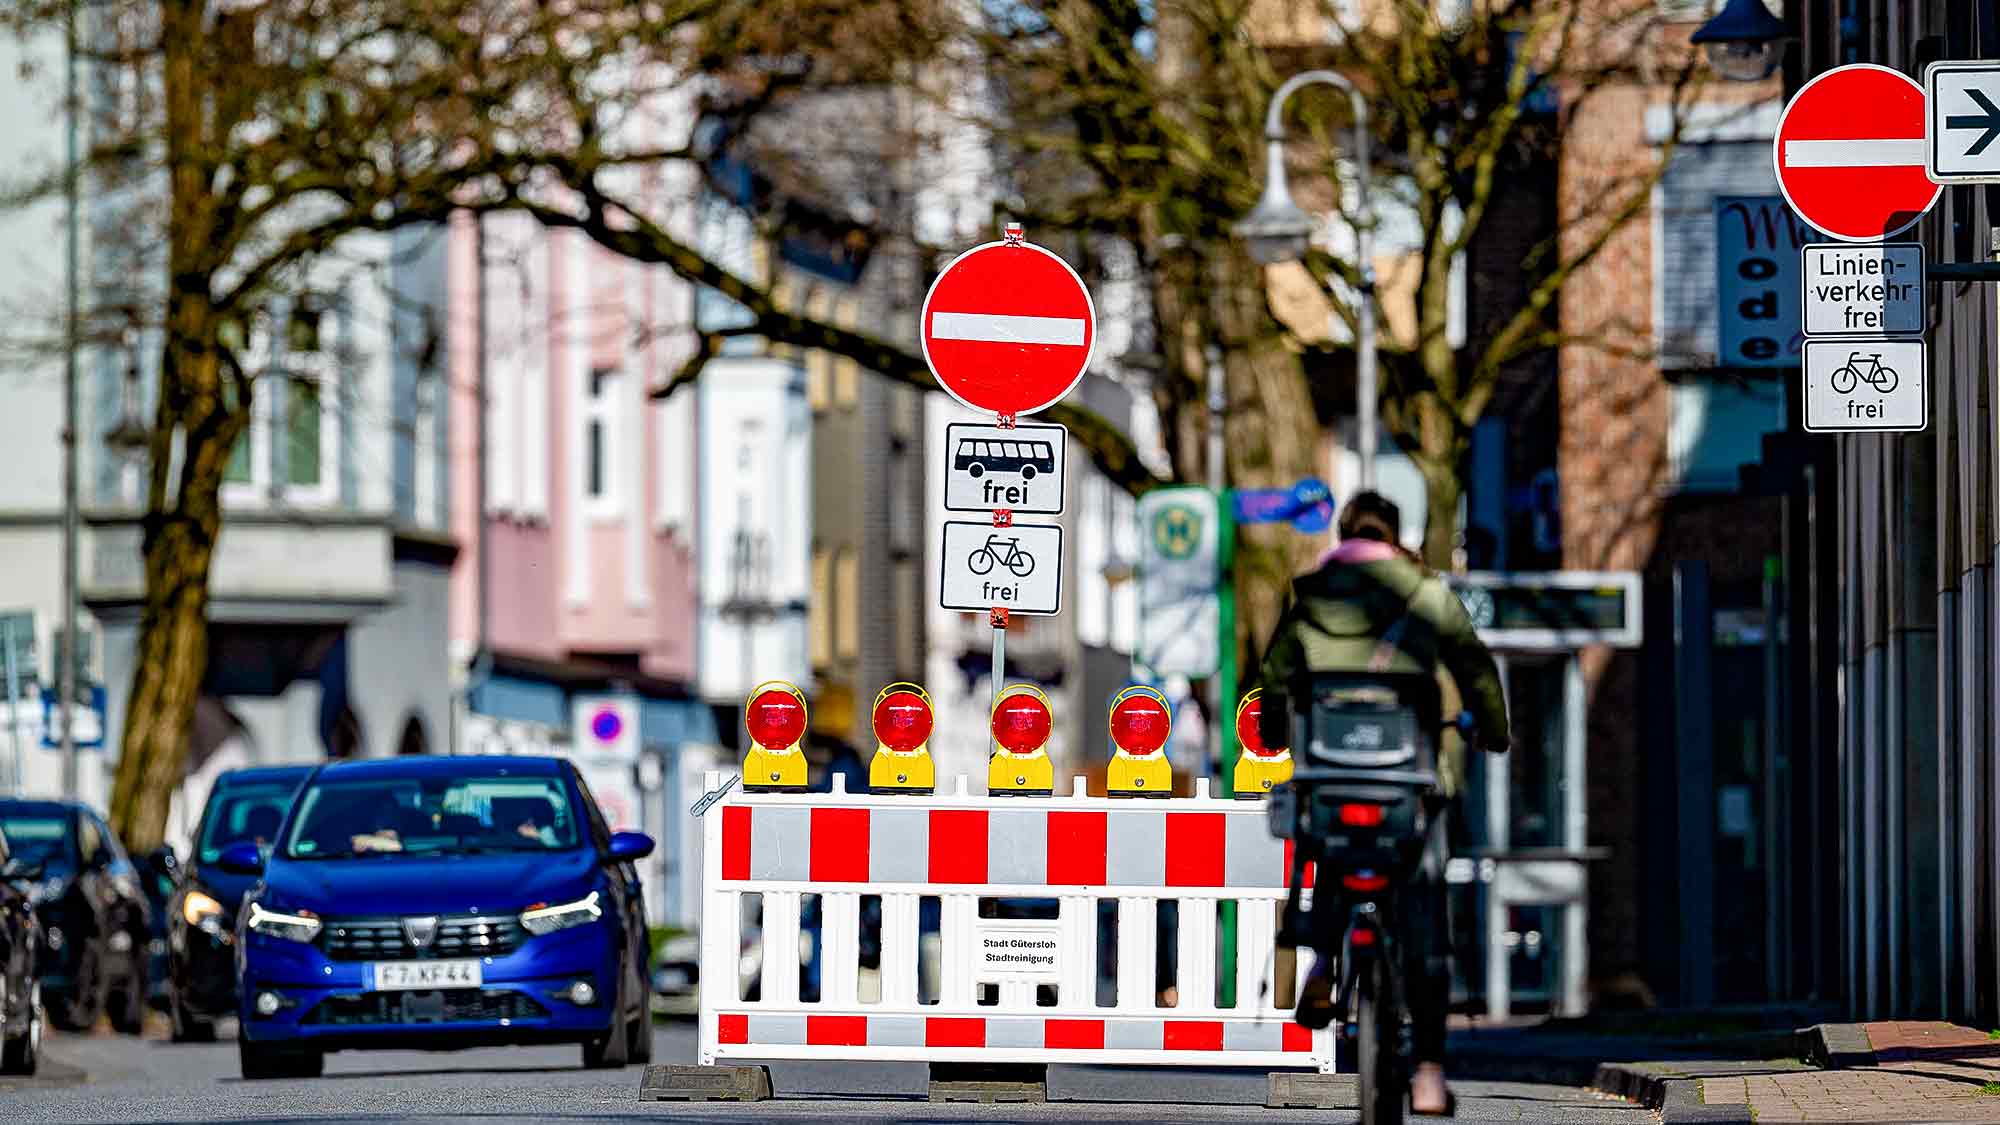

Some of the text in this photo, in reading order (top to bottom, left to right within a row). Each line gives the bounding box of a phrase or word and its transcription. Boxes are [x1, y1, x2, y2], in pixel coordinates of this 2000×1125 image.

[1819, 252, 1907, 276] Linien-
[1815, 278, 1913, 302] verkehr
[1844, 305, 1885, 328] frei
[1847, 399, 1885, 418] frei
[982, 479, 1029, 505] frei
[982, 581, 1020, 601] frei
[983, 938, 1057, 949] Stadt Gütersloh
[985, 952, 1054, 965] Stadtreinigung
